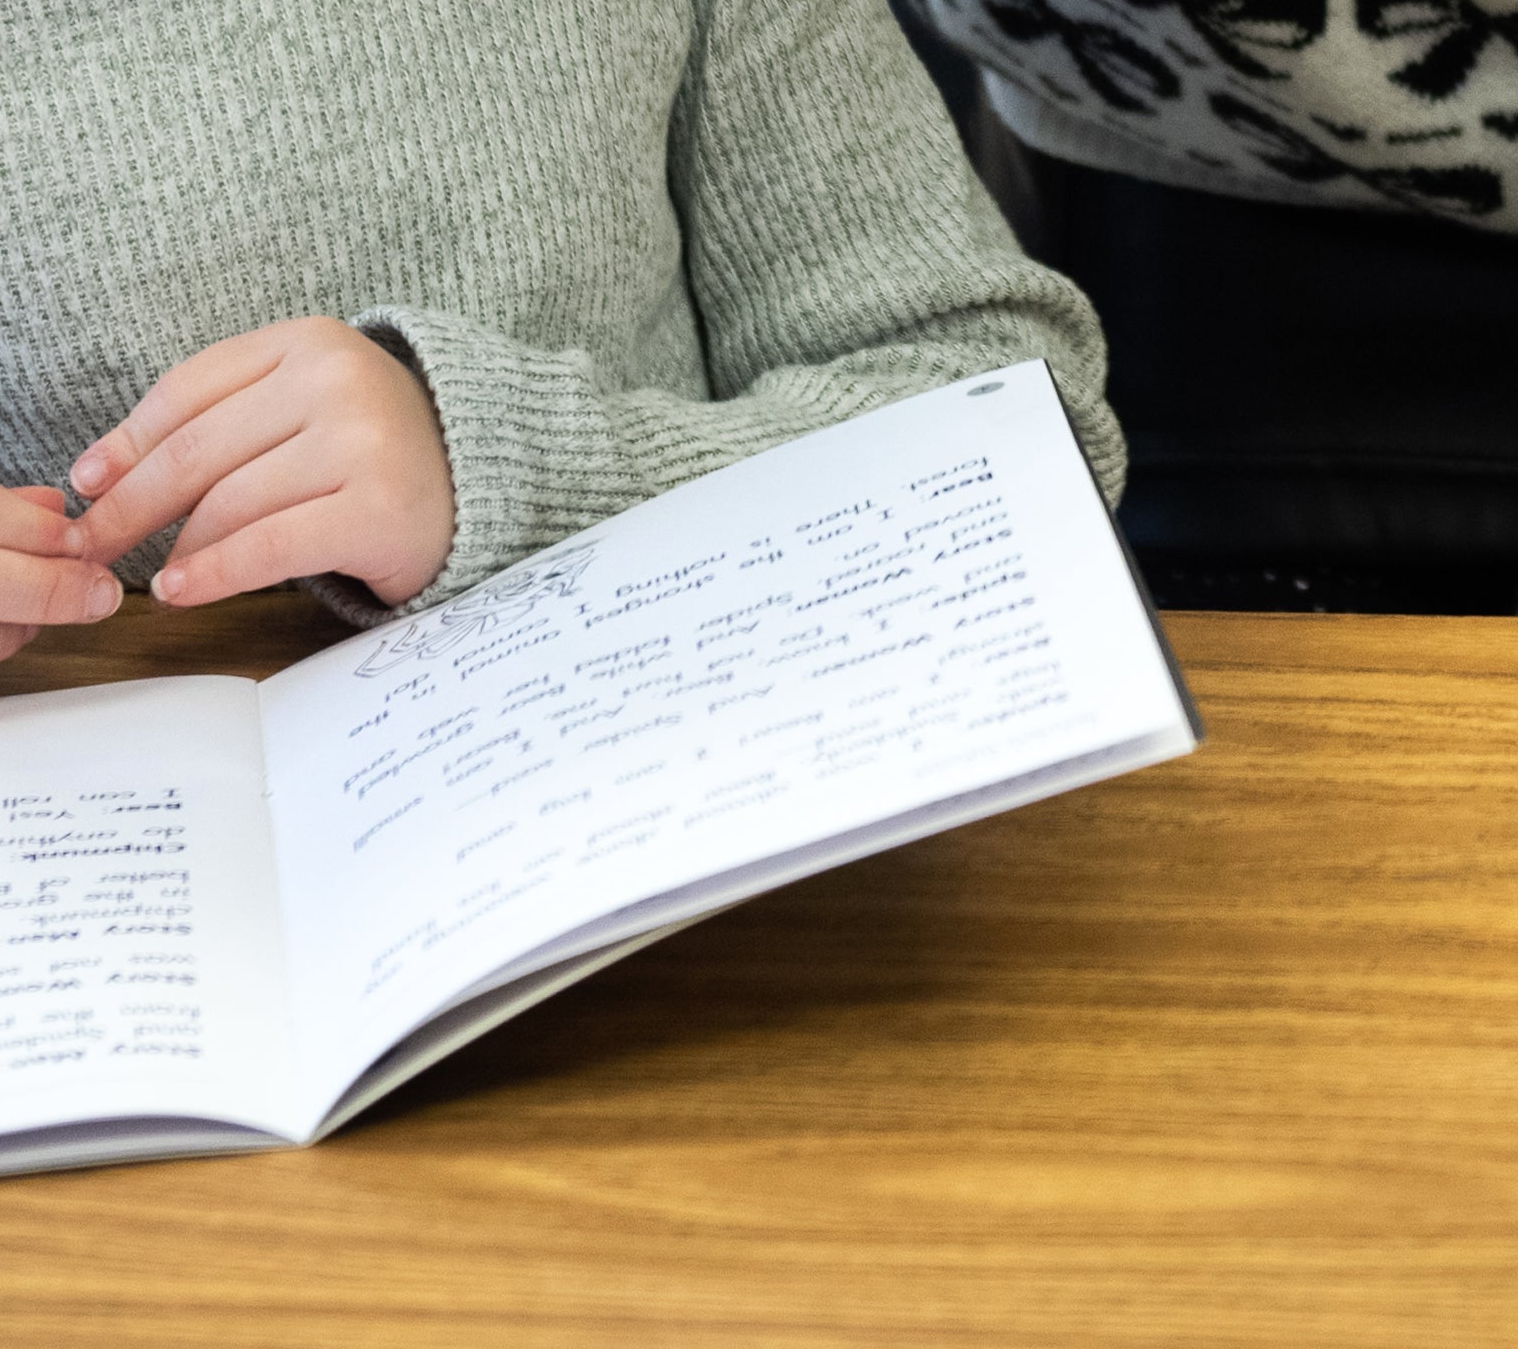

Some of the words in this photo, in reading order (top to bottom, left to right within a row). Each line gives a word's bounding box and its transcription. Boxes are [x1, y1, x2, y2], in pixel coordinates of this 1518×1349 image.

[903, 455, 987, 491] forest.
[922, 471, 992, 500] Bear:
[795, 498, 873, 532] There
[879, 508, 891, 519] I
[904, 495, 1001, 542] moved
[808, 524, 851, 545] am
[950, 511, 1007, 543] and
[750, 536, 769, 547] is
[836, 541, 879, 561] on.
[933, 528, 1011, 562] Story
[740, 549, 782, 568] the
[616, 551, 725, 597] nothing
[584, 574, 713, 629] strongest
[796, 567, 911, 611] Woman:
[575, 602, 589, 614] I
[695, 592, 791, 630] Spider
[453, 617, 548, 667] cannot
[696, 619, 759, 651] And
[461, 629, 560, 681] animal
[575, 634, 669, 674] folded
[590, 650, 670, 680] while
[385, 672, 429, 702] do!
[412, 683, 435, 700] in
[503, 672, 548, 697] her
[499, 682, 564, 715] Bear
[349, 709, 388, 737] the
[418, 706, 478, 739] web
[343, 748, 396, 793] and
[350, 720, 473, 800] growled
[3, 795, 51, 808] roll
[79, 791, 135, 801] can
[162, 788, 178, 798] I
[10, 809, 73, 822] Yes!
[104, 801, 181, 812] Bear:
[143, 826, 184, 839] do
[11, 842, 186, 862] Chipmunk:
[37, 877, 70, 893] of
[96, 869, 188, 884] better
[84, 889, 133, 903] the
[160, 886, 189, 900] in
[0, 929, 80, 944] Man:
[102, 923, 192, 935] Story
